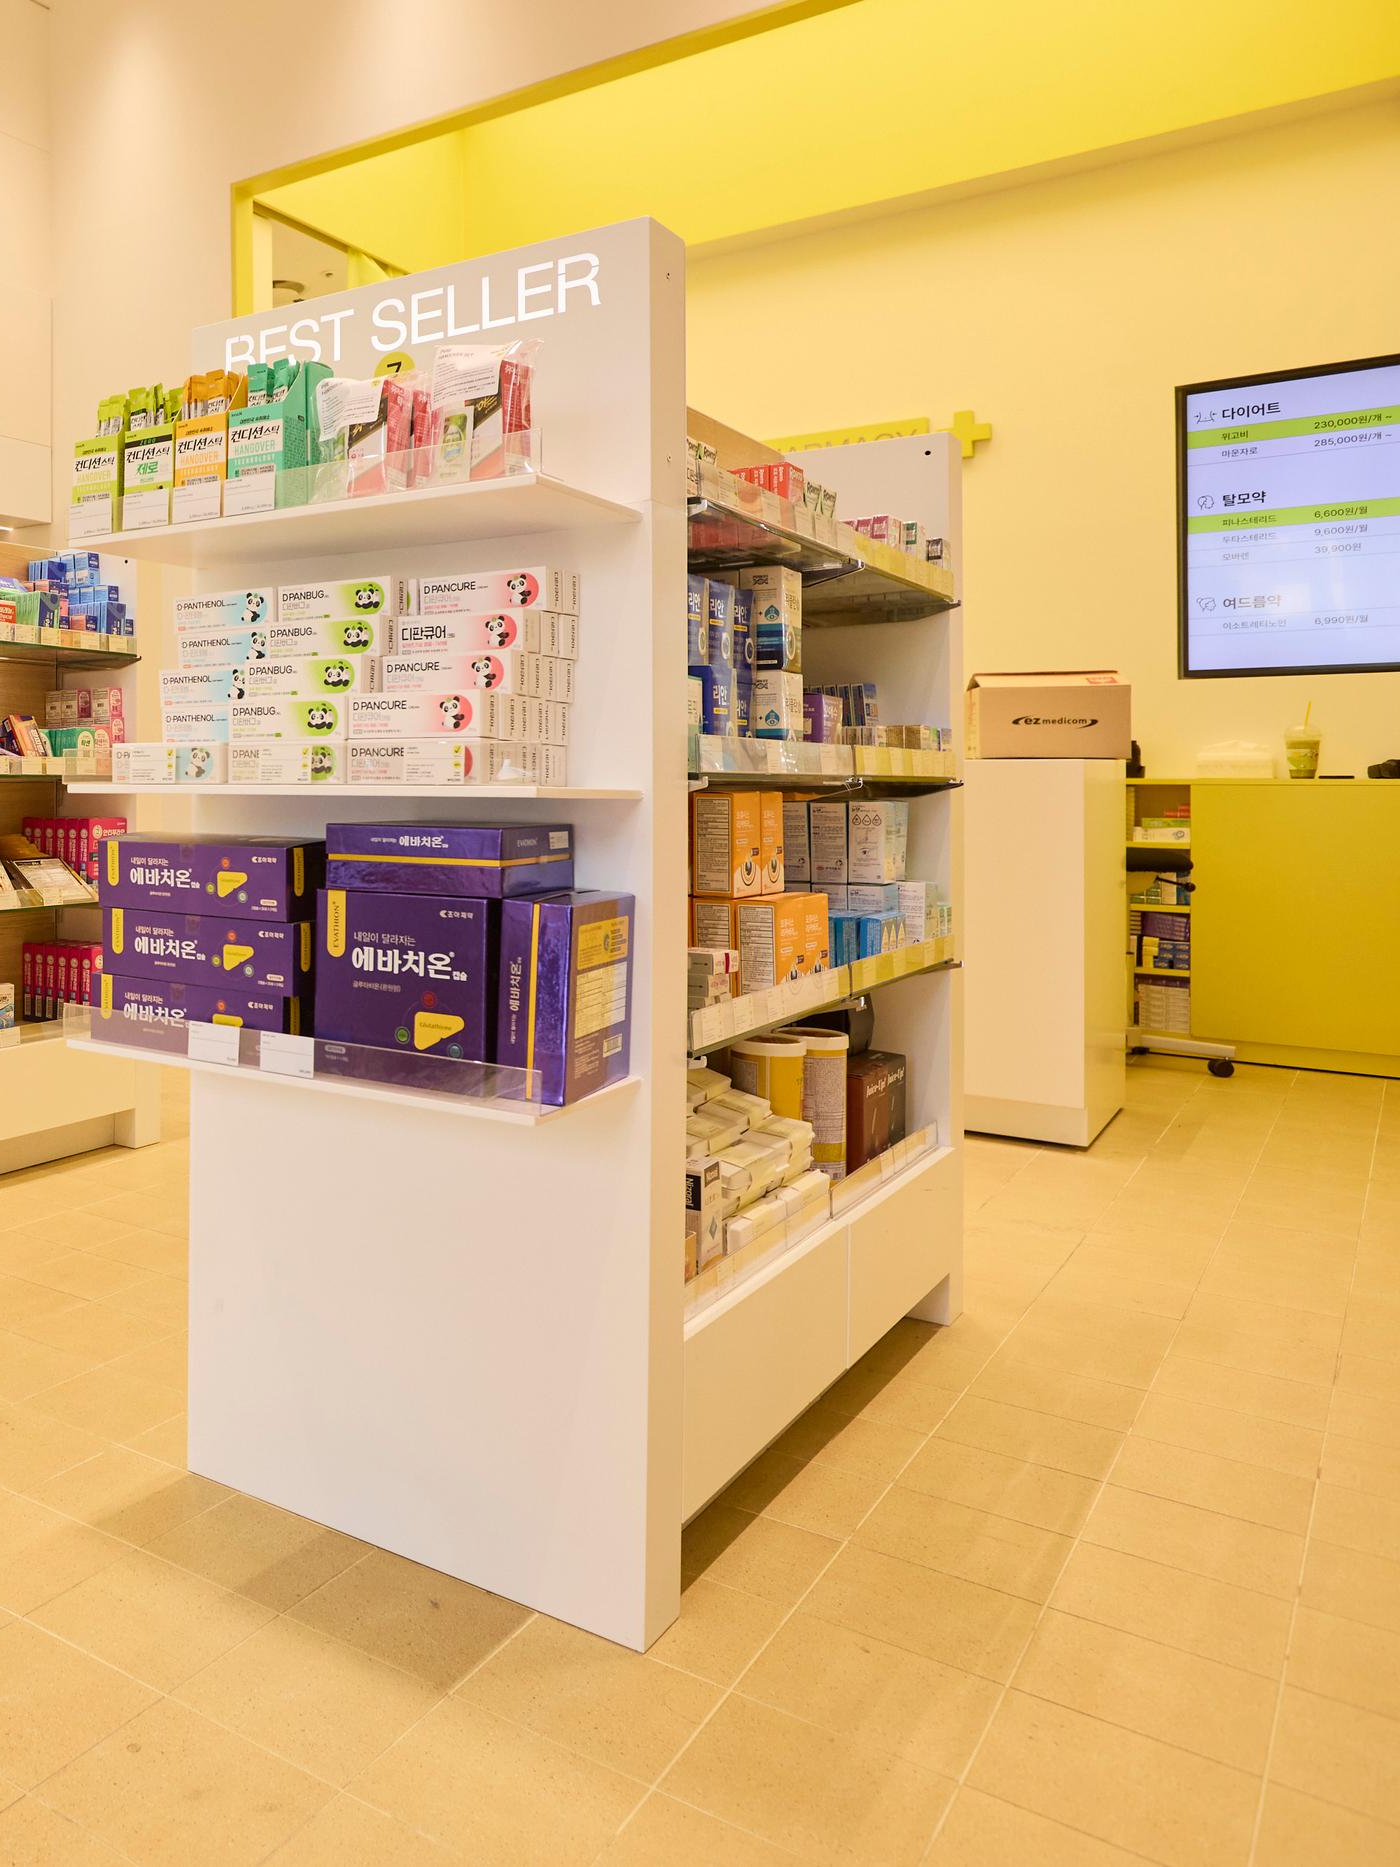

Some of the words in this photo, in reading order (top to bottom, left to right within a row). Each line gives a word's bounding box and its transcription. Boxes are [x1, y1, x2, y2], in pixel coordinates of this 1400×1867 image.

[225, 309, 354, 372] BEST
[371, 252, 601, 351] SELLER
[1221, 401, 1281, 421] 다이어트
[1221, 431, 1249, 441] 위고비
[1314, 413, 1383, 430] 230,000원/개
[233, 440, 276, 454] HANGOVER
[1221, 447, 1259, 458] 마운자로
[1314, 432, 1383, 448] 285,000원/개
[180, 451, 219, 465] HANGOVER
[136, 461, 159, 476] 제로
[1222, 490, 1267, 507] 탈모약
[1222, 514, 1278, 527] 피나스테리드
[1314, 506, 1369, 519] 6,600원/월
[1314, 523, 1369, 537] 9,600원/월
[1314, 542, 1362, 555] 39,900원
[709, 599, 725, 618] 리안
[1223, 594, 1283, 610] 여드름약
[1222, 619, 1288, 630] 이소트레티노인
[1314, 614, 1369, 626] 6,990원/월
[401, 625, 447, 641] 디판큐어
[713, 684, 728, 705] 리안
[398, 834, 443, 849] 에바치온
[130, 856, 147, 866] 내일이
[147, 857, 169, 867] 달라지는
[129, 867, 192, 889] 에바치온
[135, 926, 152, 935] 내일이
[152, 926, 175, 937] 달라지는
[332, 903, 340, 948] EVATHION
[354, 931, 379, 944] 내일이
[381, 931, 417, 947] 달라지는
[134, 936, 197, 960] 에바치온
[351, 946, 453, 980] 에바치온
[452, 969, 468, 982] 캡슐
[124, 991, 141, 1001] 내일이
[141, 993, 164, 1004] 달라지는
[123, 1002, 186, 1028] 에바치온
[686, 1177, 695, 1208] Nizoral
